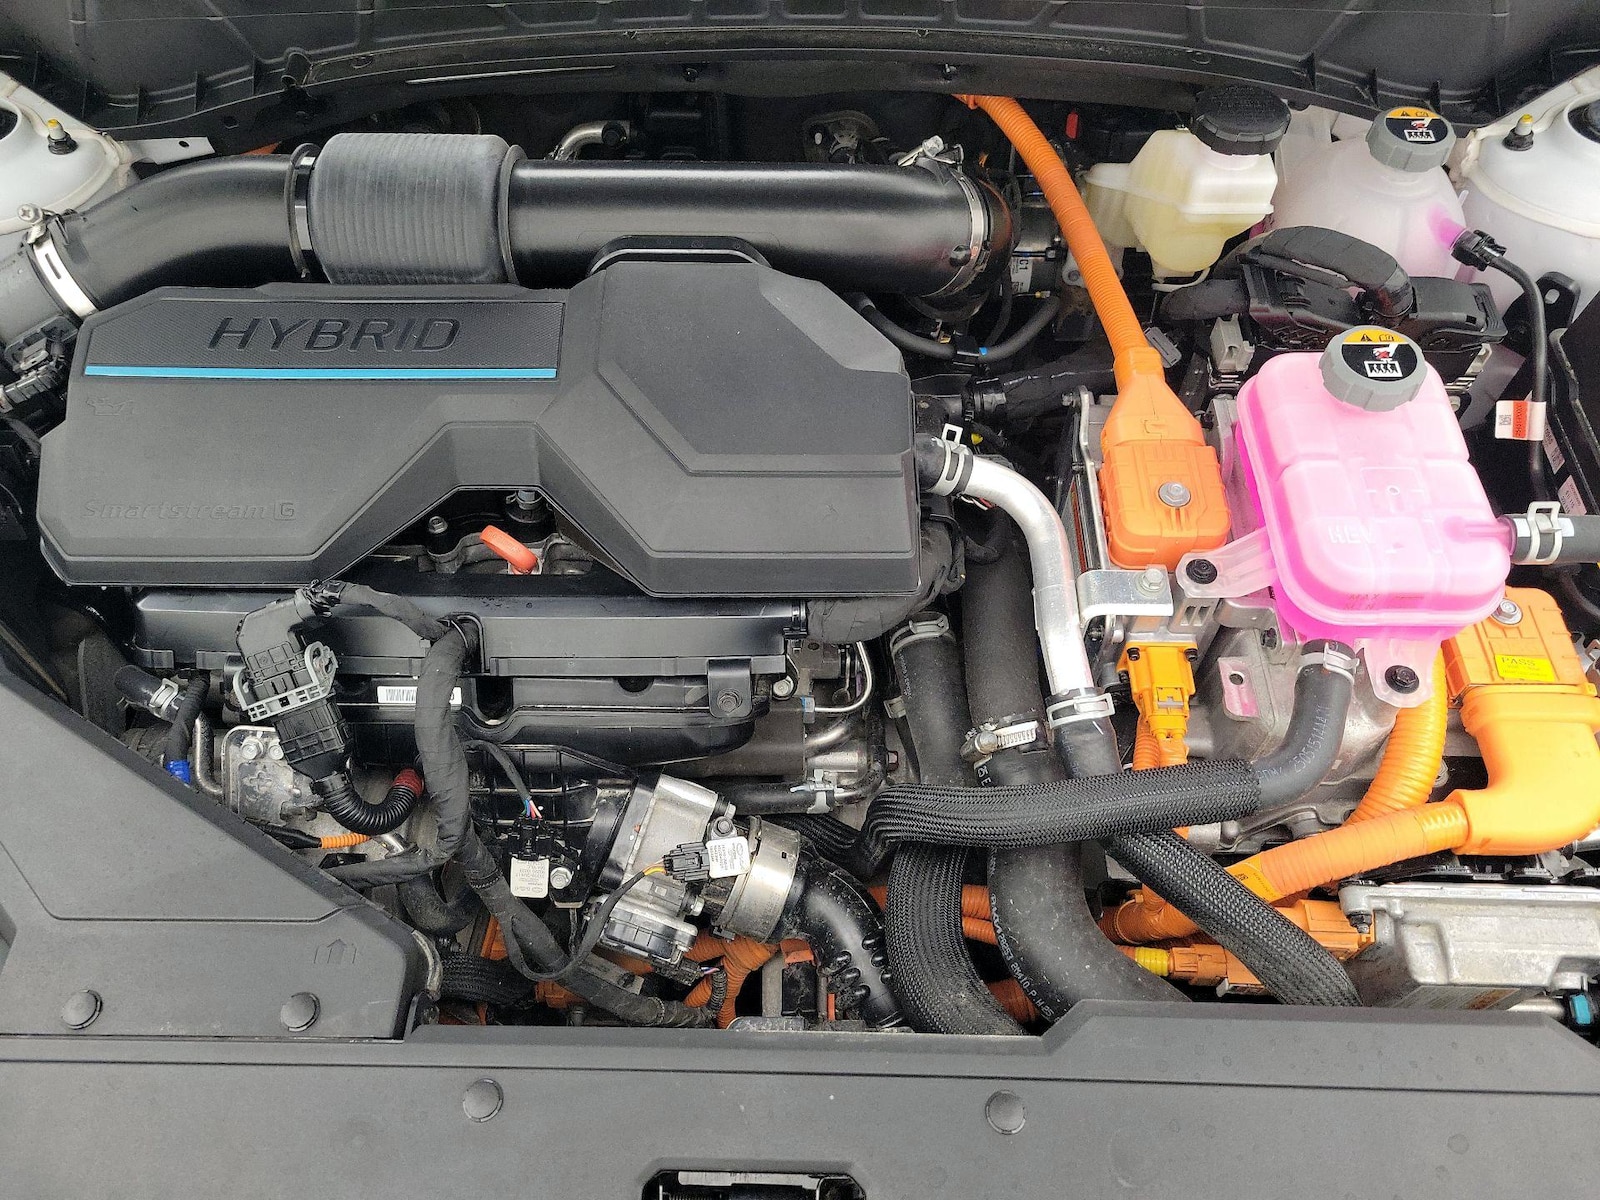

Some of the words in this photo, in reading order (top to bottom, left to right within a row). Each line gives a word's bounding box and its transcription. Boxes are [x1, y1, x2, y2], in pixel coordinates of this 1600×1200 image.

[207, 317, 461, 352] HYBRID
[81, 500, 267, 520] Smartstream
[278, 501, 296, 518] G
[1501, 656, 1536, 666] PASS
[998, 932, 1014, 961] 28253
